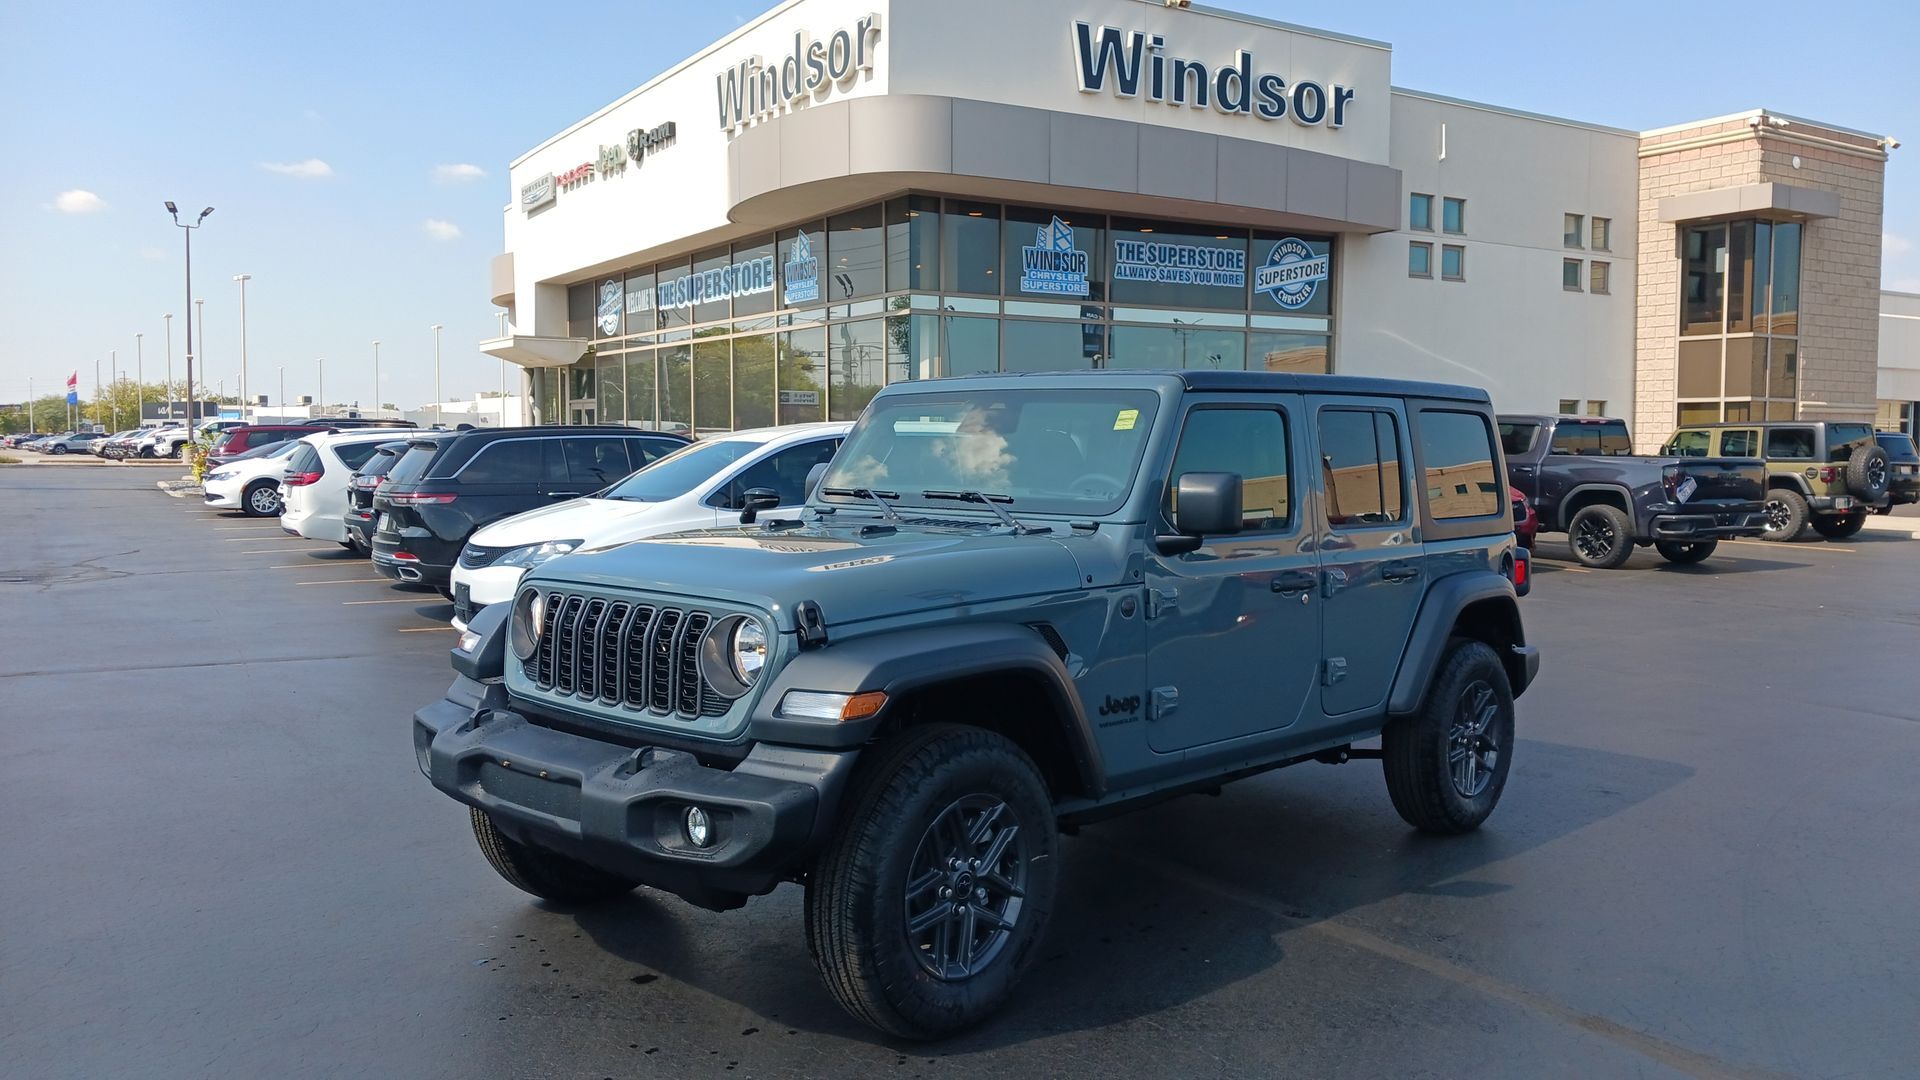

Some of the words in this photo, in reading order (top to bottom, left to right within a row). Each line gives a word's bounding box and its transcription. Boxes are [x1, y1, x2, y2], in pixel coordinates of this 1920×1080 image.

[716, 13, 879, 130] Windsor
[1073, 22, 1355, 127] Windsor
[640, 121, 675, 149] RAM
[595, 144, 625, 173] Jeep
[521, 177, 549, 196] CHRYSLER
[556, 162, 593, 187] DODGE
[1024, 249, 1086, 273] WINDSOR
[1116, 242, 1145, 261] THE
[1147, 244, 1244, 270] SUPERSTORE
[1273, 243, 1307, 262] WINDSOR
[659, 283, 675, 307] THE
[678, 259, 773, 304] SUPERSTORE
[1023, 280, 1087, 292] SUPERSTORE
[1030, 271, 1080, 282] CHRYSLER
[1115, 265, 1157, 279] ALWAYS
[1159, 268, 1191, 282] SAVES
[1193, 271, 1212, 284] YOU
[1213, 273, 1244, 286] MORE!
[1258, 262, 1326, 287] SUPERSTORE
[1278, 285, 1312, 304] CHRYSLER
[1099, 694, 1140, 716] Jeep
